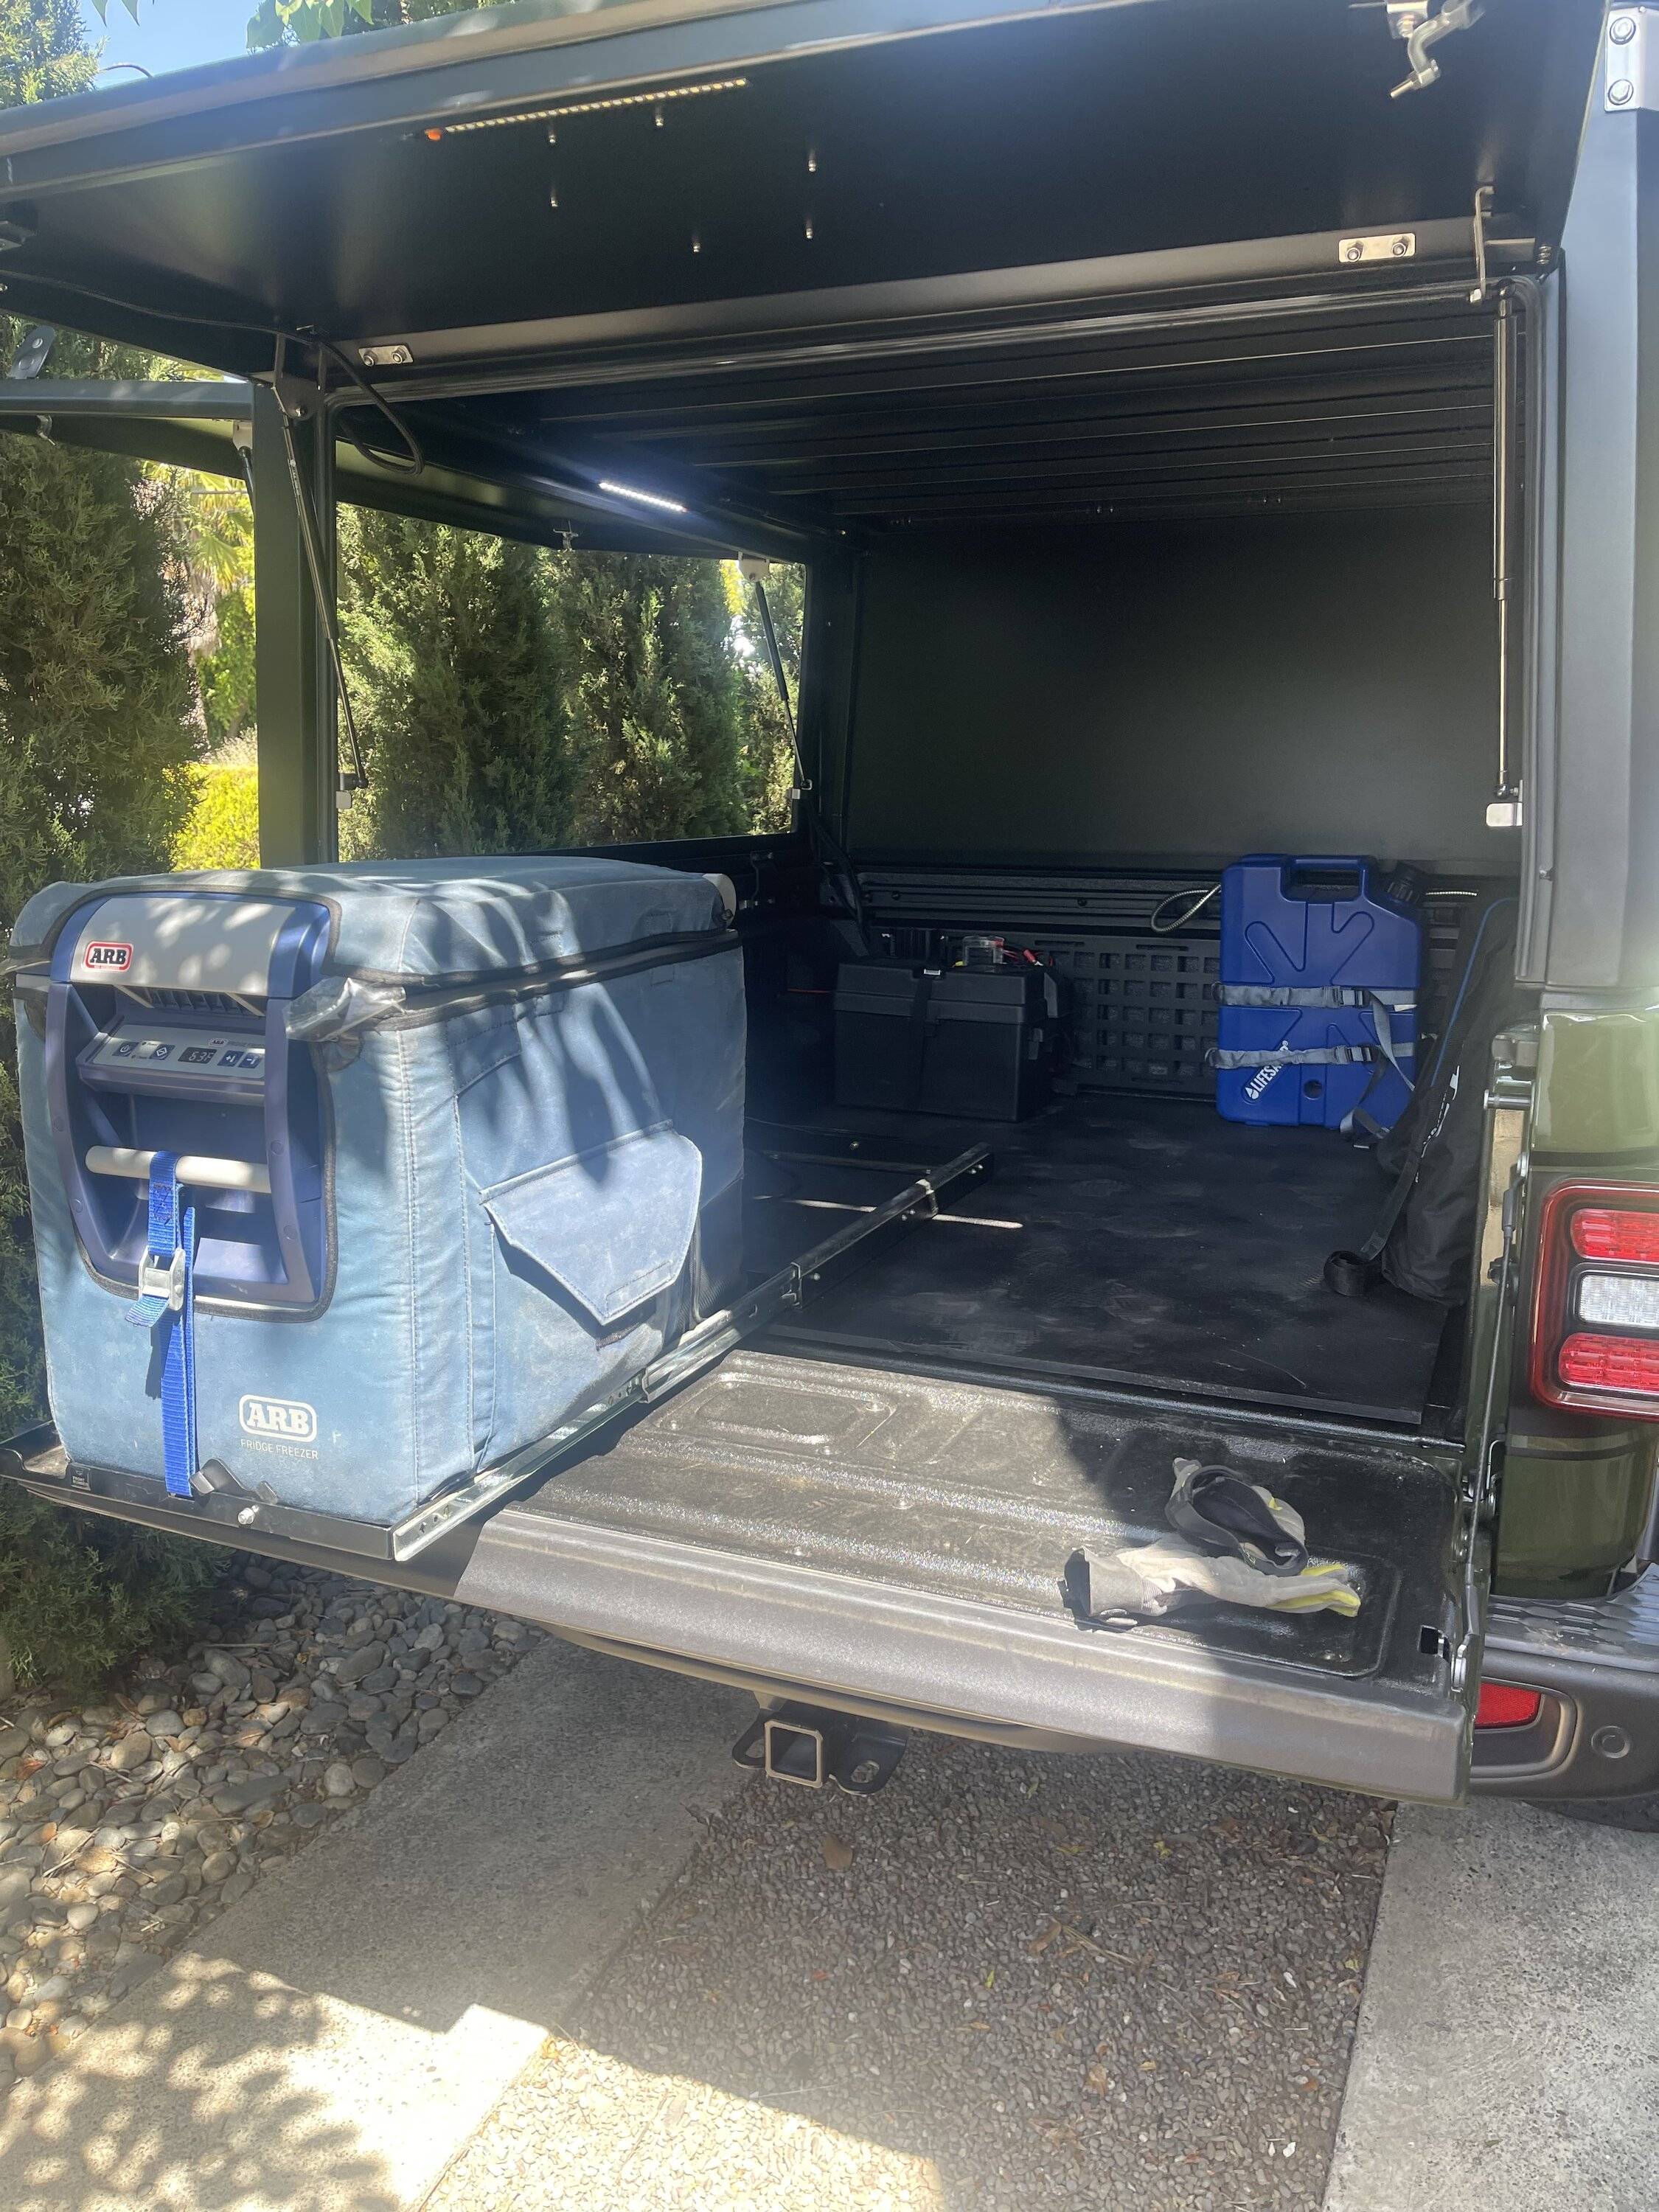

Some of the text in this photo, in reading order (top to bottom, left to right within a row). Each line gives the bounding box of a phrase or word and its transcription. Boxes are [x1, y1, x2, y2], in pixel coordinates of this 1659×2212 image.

[90, 947, 127, 964] ARB
[246, 1402, 309, 1435] ARB
[240, 1439, 319, 1460] FRIDGE FREEZER
